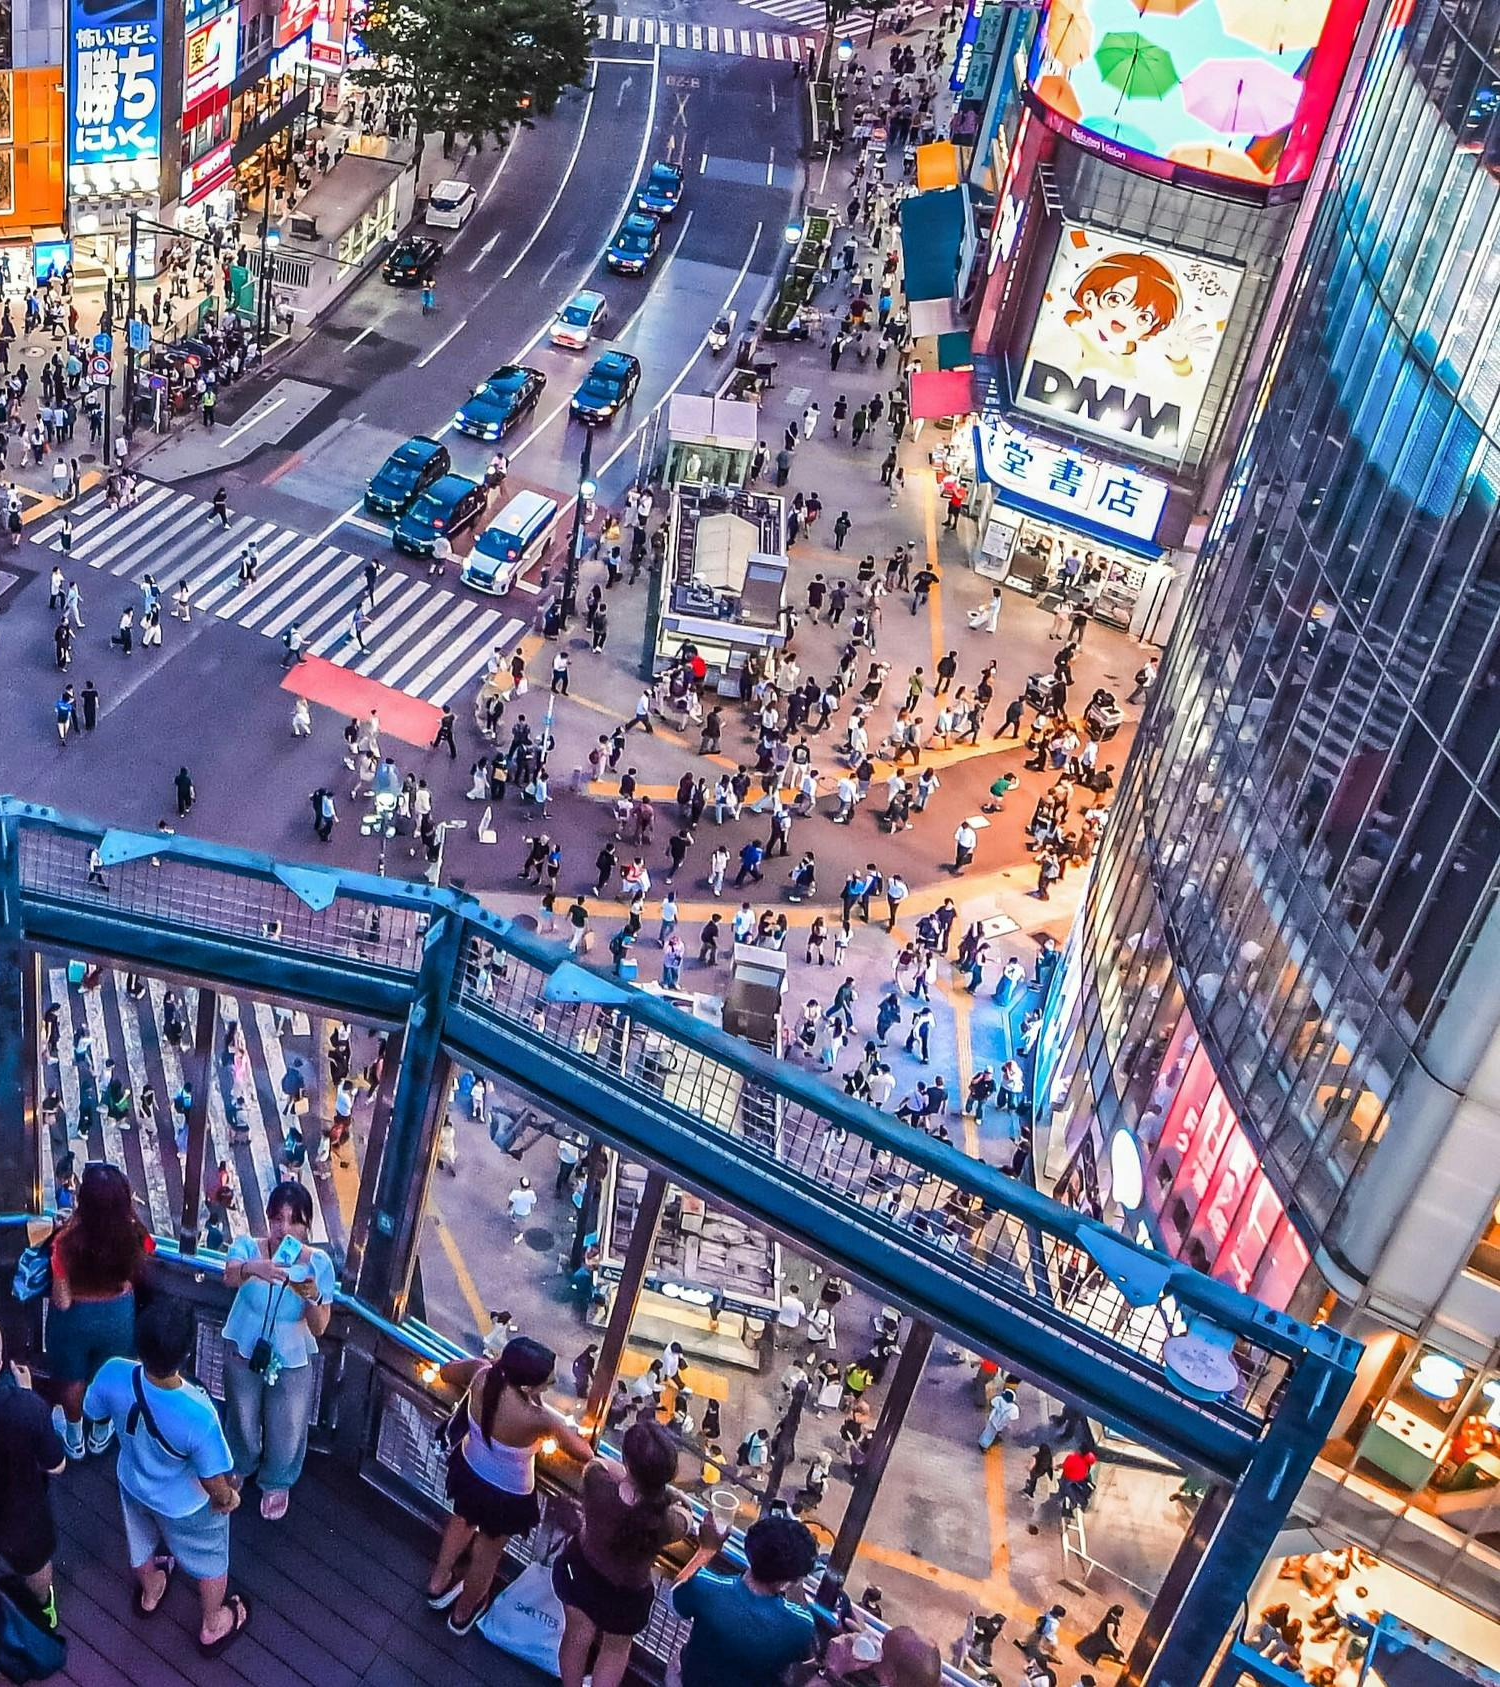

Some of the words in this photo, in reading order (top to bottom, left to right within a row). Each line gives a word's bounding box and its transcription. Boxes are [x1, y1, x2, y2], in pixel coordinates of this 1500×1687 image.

[76, 24, 157, 48] 怖いほど、
[76, 46, 156, 126] 勝ち
[76, 121, 157, 152] にいく。
[1071, 128, 1101, 149] Rakuten
[1101, 142, 1126, 160] Vision
[1024, 360, 1180, 448] DMM
[989, 434, 1143, 517] 堂書店
